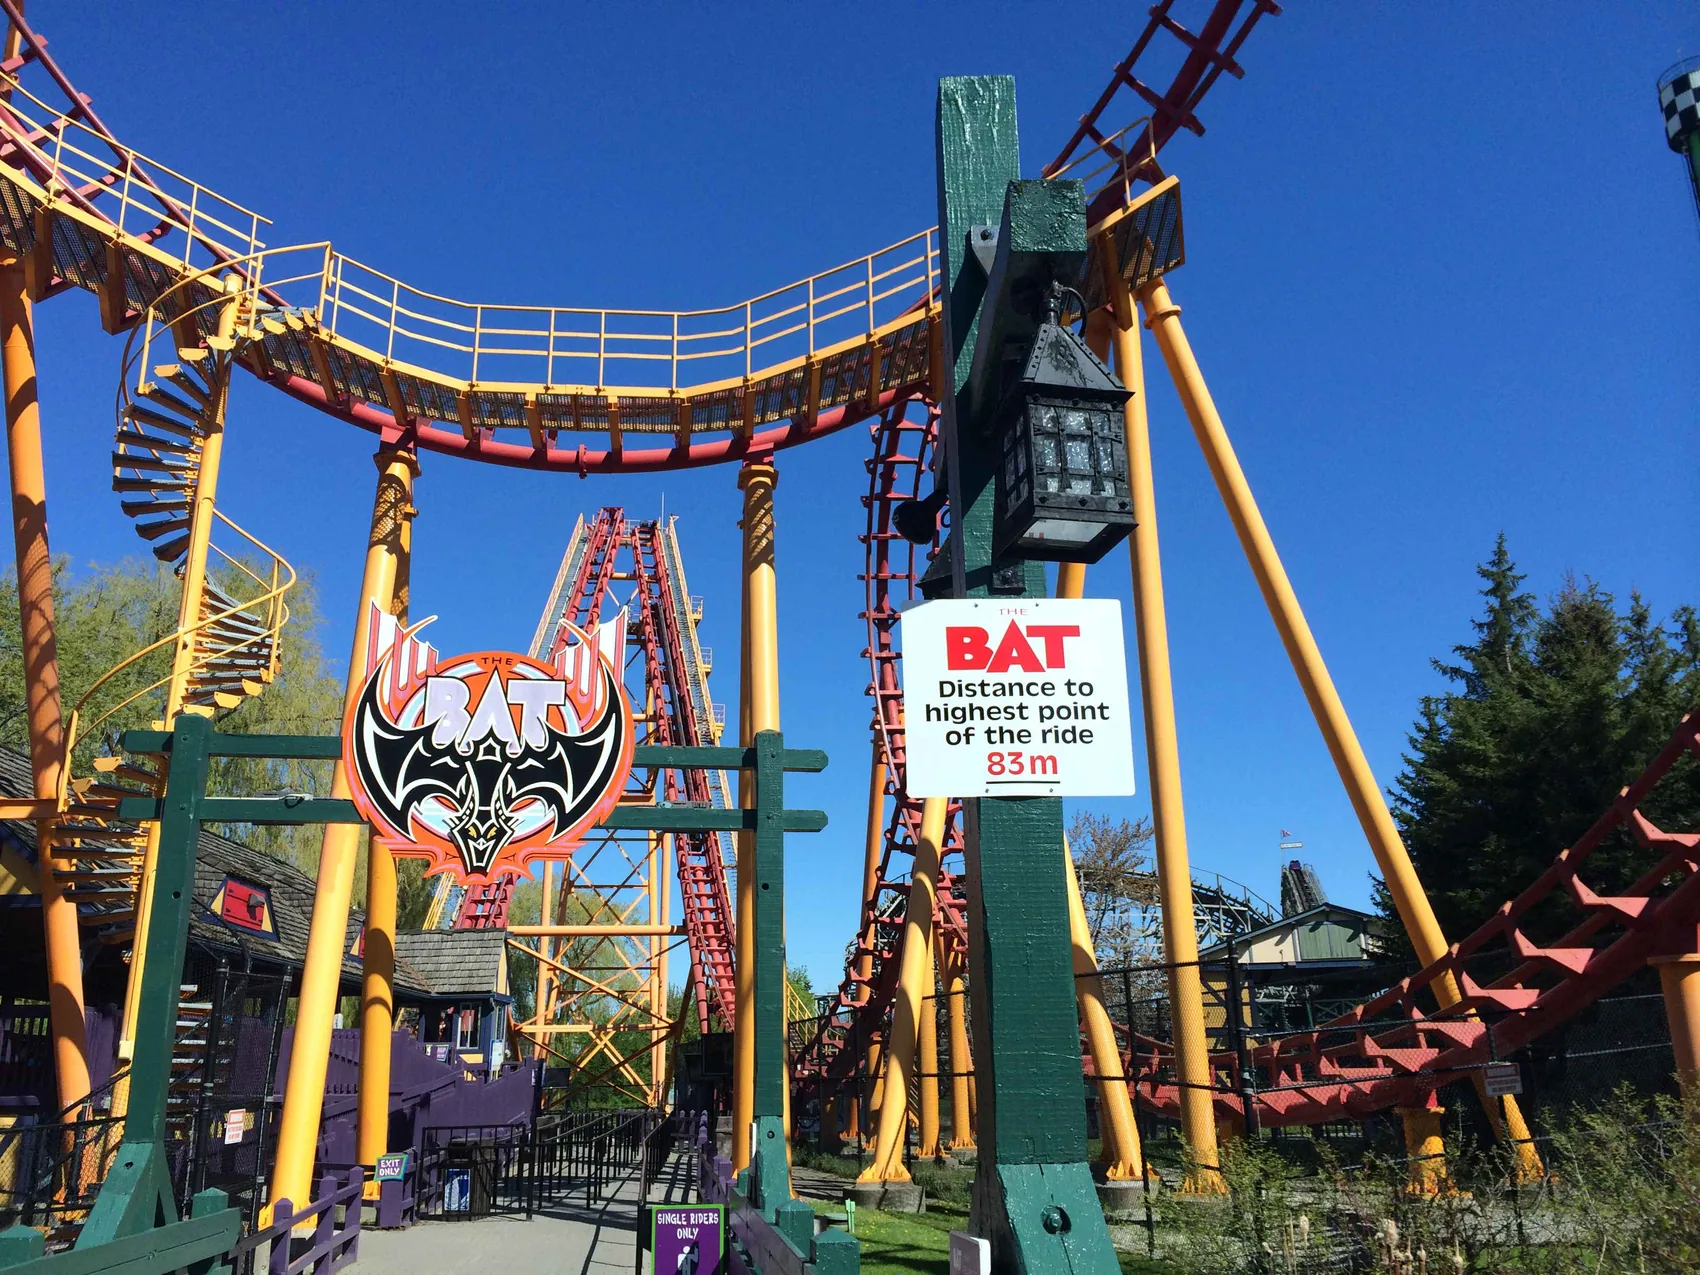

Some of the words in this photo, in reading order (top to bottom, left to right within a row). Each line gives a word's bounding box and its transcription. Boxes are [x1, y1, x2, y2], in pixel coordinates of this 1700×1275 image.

[999, 608, 1029, 616] THE
[945, 618, 1081, 673] BAT
[481, 657, 514, 666] THE
[938, 679, 1056, 698] Distance
[1064, 678, 1094, 697] to
[424, 666, 567, 757] BAT
[925, 702, 1029, 725] highest
[1038, 701, 1110, 724] point
[945, 726, 975, 746] of
[984, 725, 1032, 745] the
[1041, 724, 1094, 744] ride
[380, 1159, 400, 1167] EXIT
[379, 1168, 400, 1176] ONLY
[657, 1212, 687, 1225] SINGLE
[690, 1212, 719, 1225] RIDERS
[676, 1227, 699, 1240] ONLY
